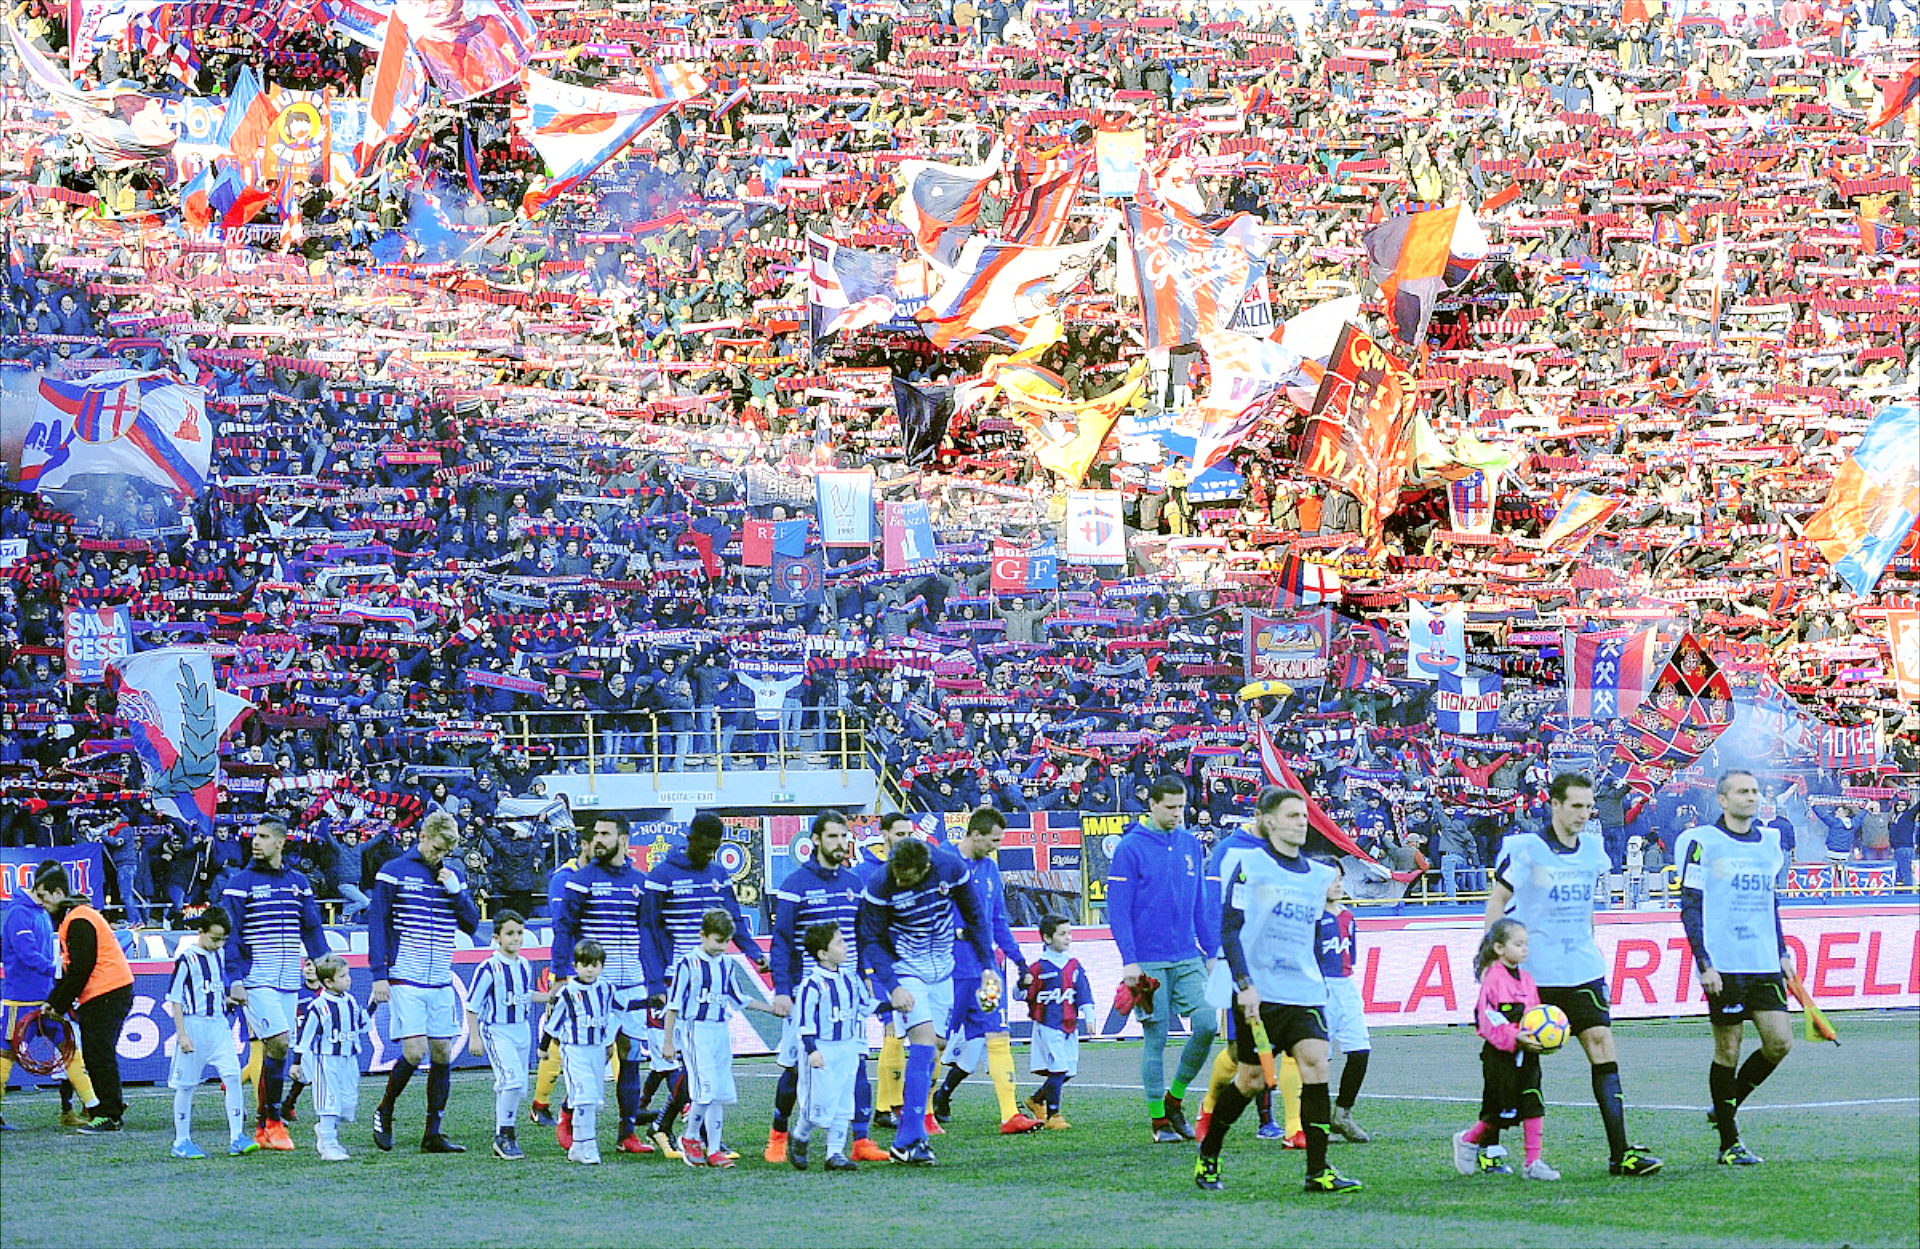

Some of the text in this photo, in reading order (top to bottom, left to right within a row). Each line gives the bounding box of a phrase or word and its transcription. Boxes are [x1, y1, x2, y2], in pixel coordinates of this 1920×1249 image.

[68, 611, 127, 637] SALA
[68, 637, 127, 662] GESSI
[1440, 691, 1499, 711] MONZUNO
[1822, 725, 1874, 758] 40132
[661, 792, 688, 802] USCITA
[696, 792, 713, 802] EXIT
[1362, 945, 1458, 1015] LA
